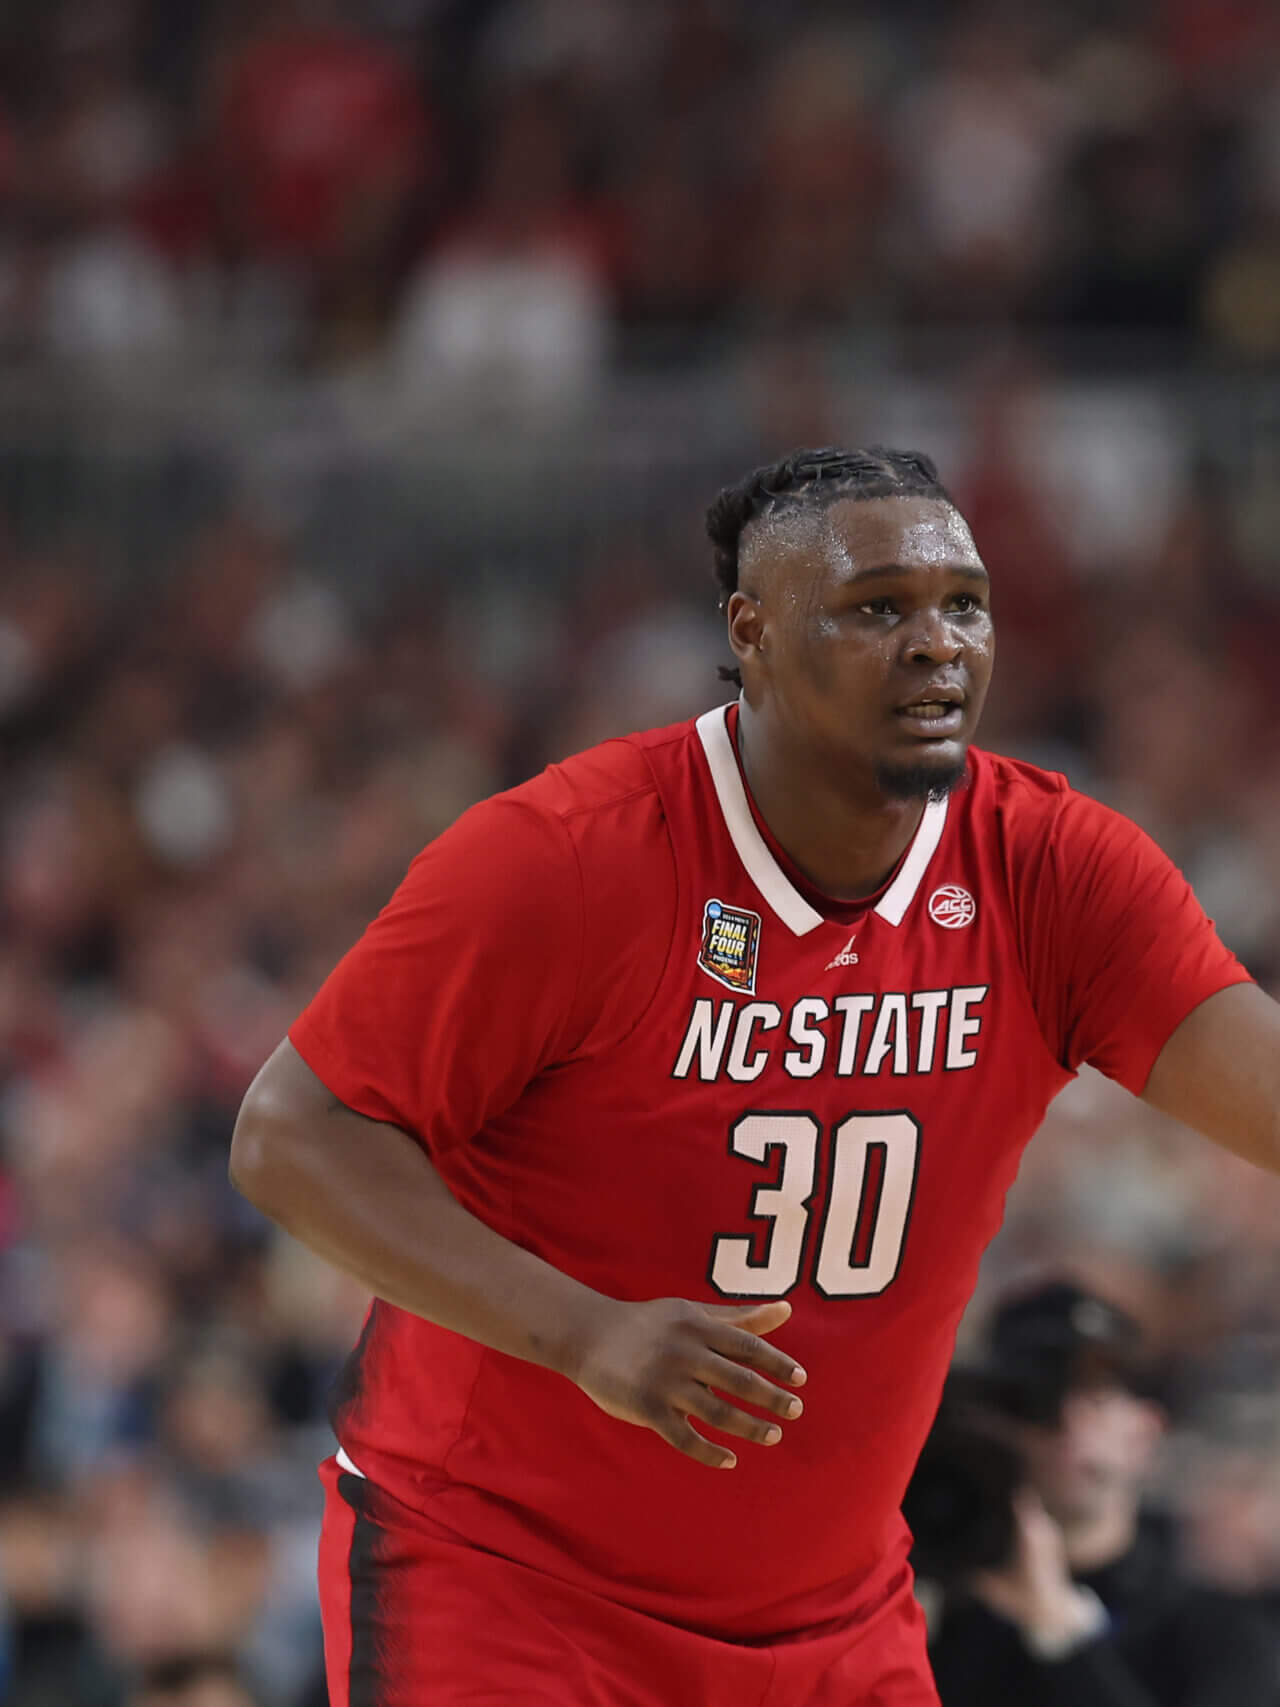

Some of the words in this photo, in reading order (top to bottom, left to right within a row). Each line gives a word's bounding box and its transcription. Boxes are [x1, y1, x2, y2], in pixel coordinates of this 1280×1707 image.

[934, 898, 972, 914] ACC
[711, 919, 747, 941] FINAL
[709, 934, 746, 957] FOUR
[671, 996, 782, 1083] NC
[783, 984, 990, 1079] STATE
[707, 1108, 923, 1299] 30
